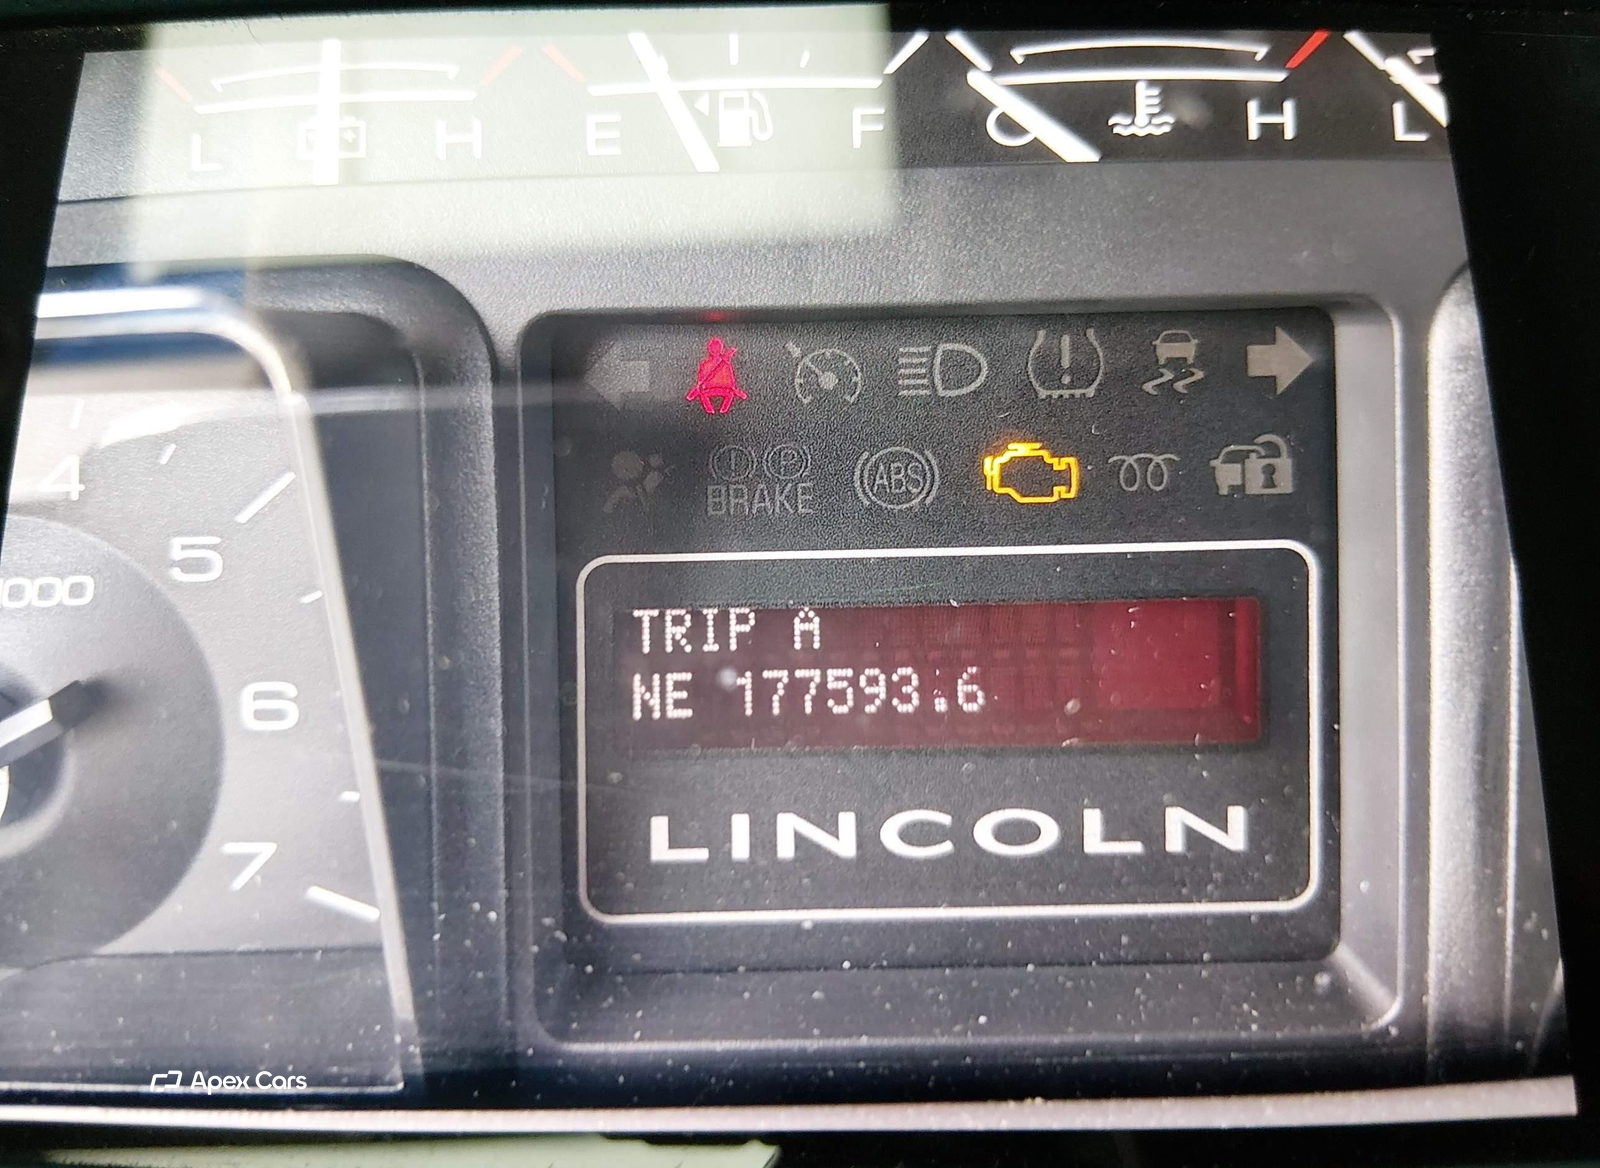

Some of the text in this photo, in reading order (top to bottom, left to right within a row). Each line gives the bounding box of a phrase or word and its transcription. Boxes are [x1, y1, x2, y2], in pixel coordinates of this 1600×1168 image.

[435, 118, 482, 160] H
[586, 114, 622, 156] E
[851, 108, 885, 149] F
[1247, 100, 1297, 140] H
[1392, 101, 1429, 142] L
[191, 133, 224, 172] L
[36, 454, 86, 502] 4
[873, 462, 925, 495] ABS
[706, 482, 814, 517] BRAKE
[168, 536, 224, 583] 5
[632, 607, 822, 655] TRIP A
[240, 681, 299, 731] 6
[632, 665, 986, 721] NE 177593.6
[649, 805, 1249, 864] LINCOLN
[221, 842, 278, 892] 7
